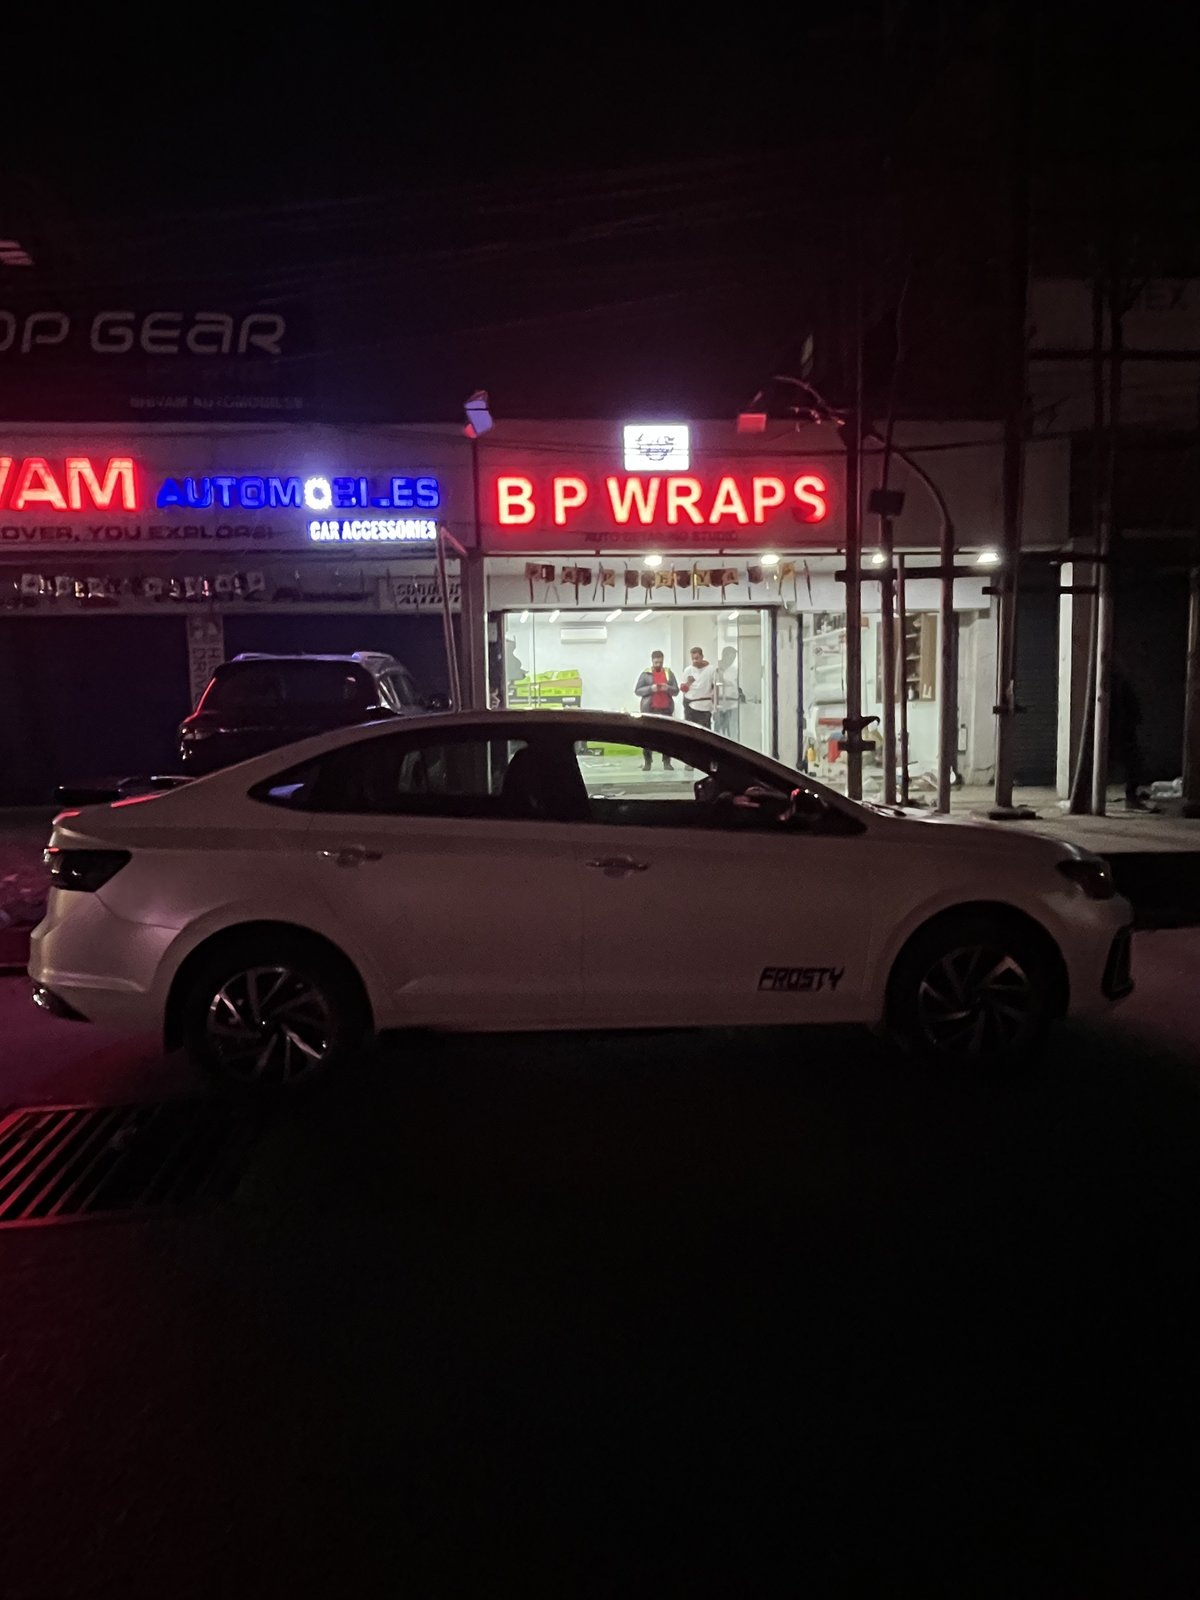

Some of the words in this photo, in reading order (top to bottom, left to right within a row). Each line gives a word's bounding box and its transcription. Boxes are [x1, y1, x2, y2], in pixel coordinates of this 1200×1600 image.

[0, 456, 139, 511] AM
[496, 475, 536, 526] B
[553, 475, 589, 526] P
[606, 474, 828, 526] WRAPS
[88, 526, 141, 541] YOU
[310, 520, 340, 541] CAR
[342, 520, 437, 541] ACCESSORIES
[758, 966, 845, 991] FROSTY
